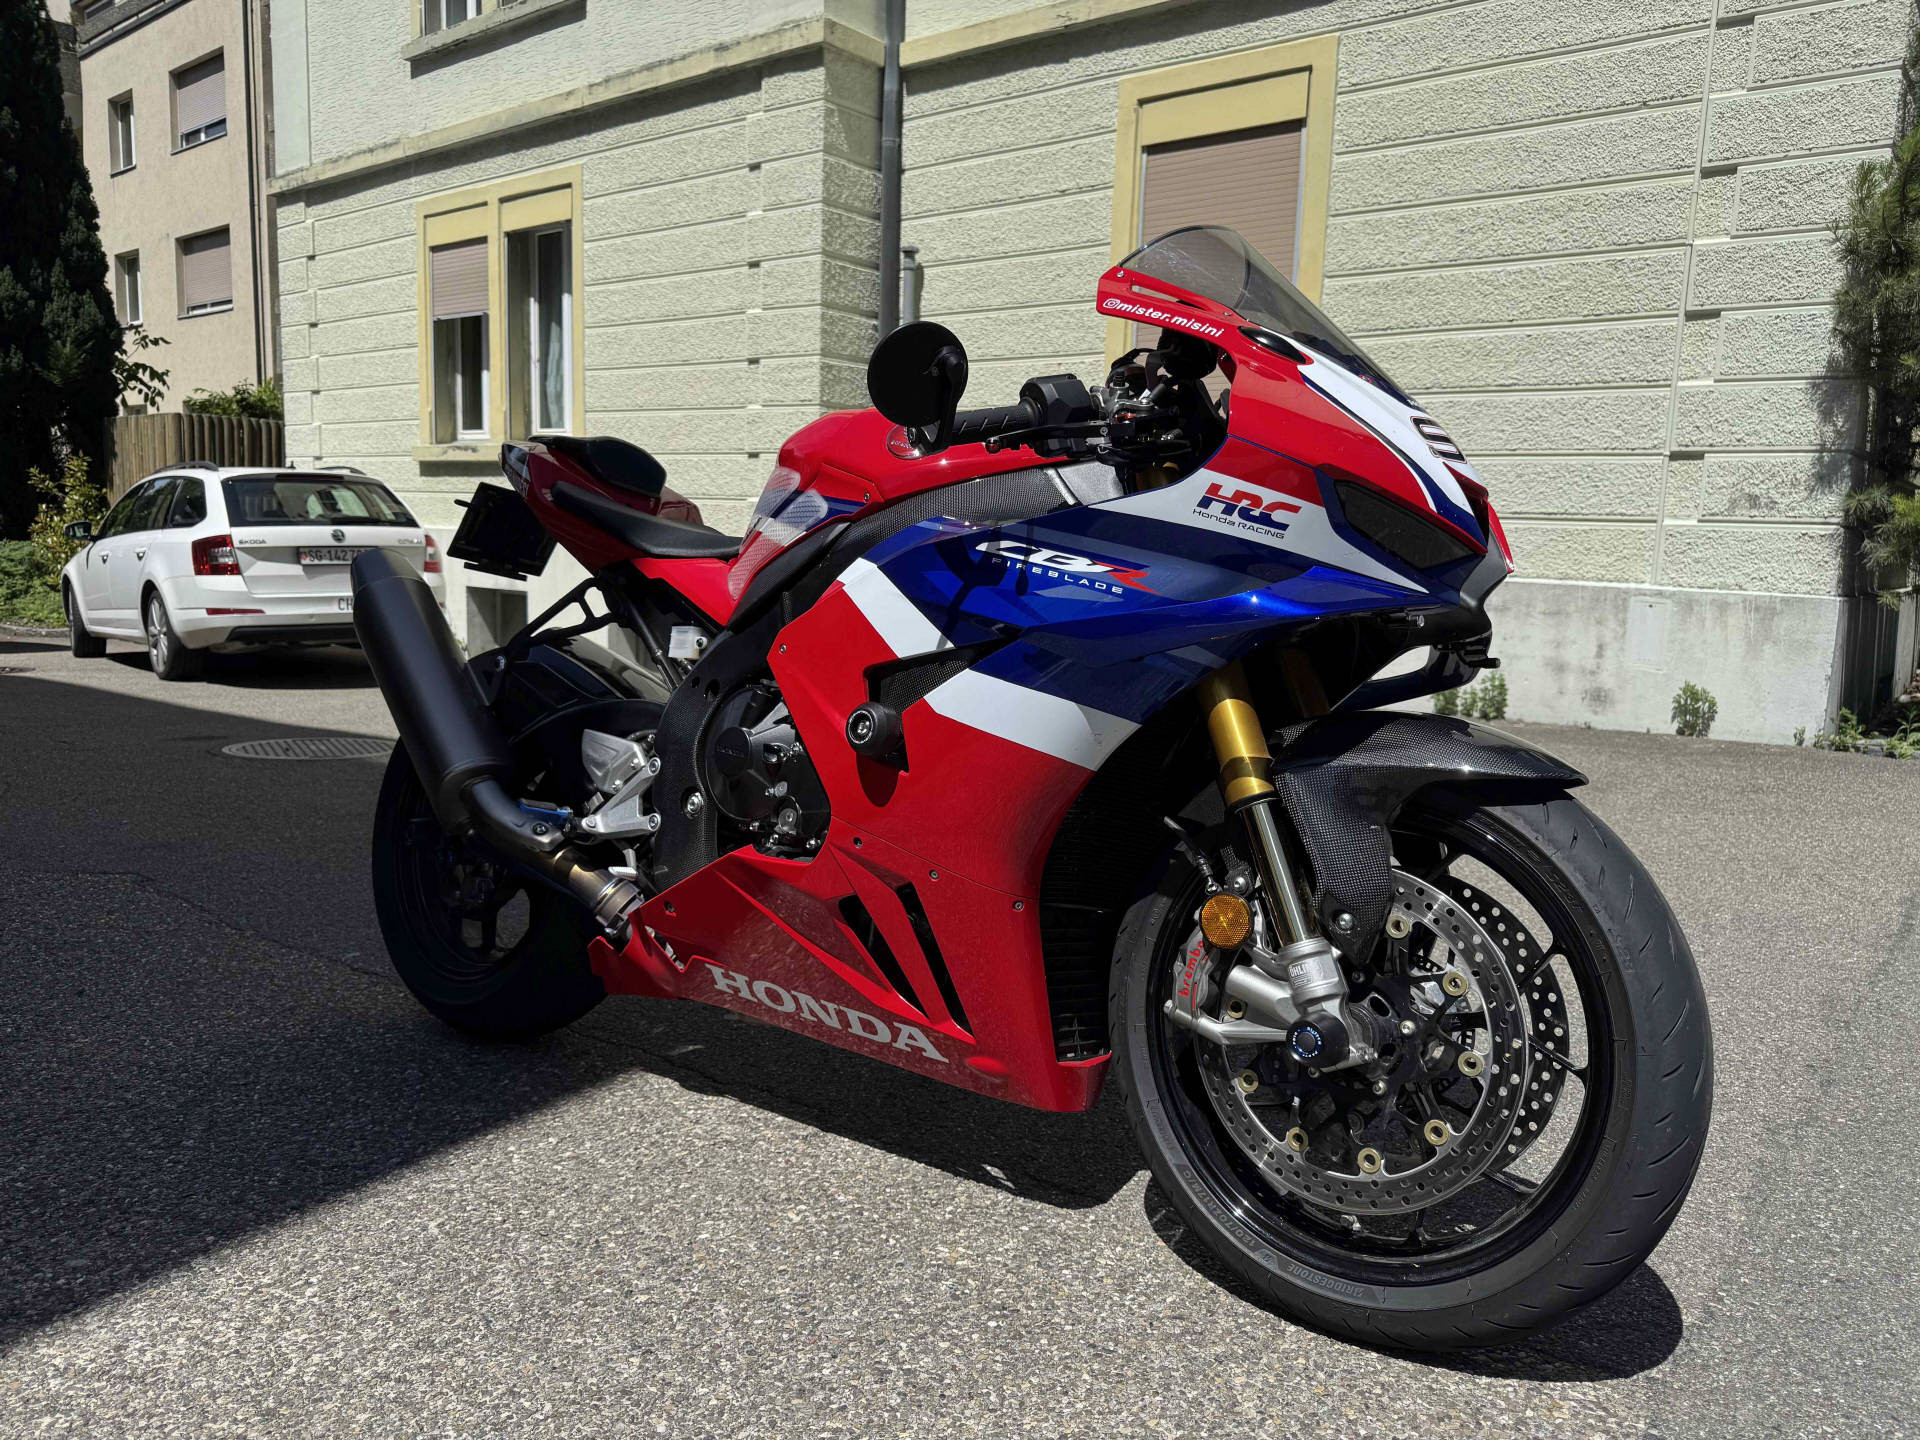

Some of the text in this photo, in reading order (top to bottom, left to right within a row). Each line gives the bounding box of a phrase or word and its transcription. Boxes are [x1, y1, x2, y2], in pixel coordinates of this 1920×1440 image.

[1115, 302, 1225, 338] mister.misini
[1196, 482, 1303, 532] HRC
[1237, 521, 1285, 540] RACING
[991, 557, 1123, 595] FIREBLADE
[1178, 940, 1205, 998] brembo
[705, 963, 950, 1064] HONDA
